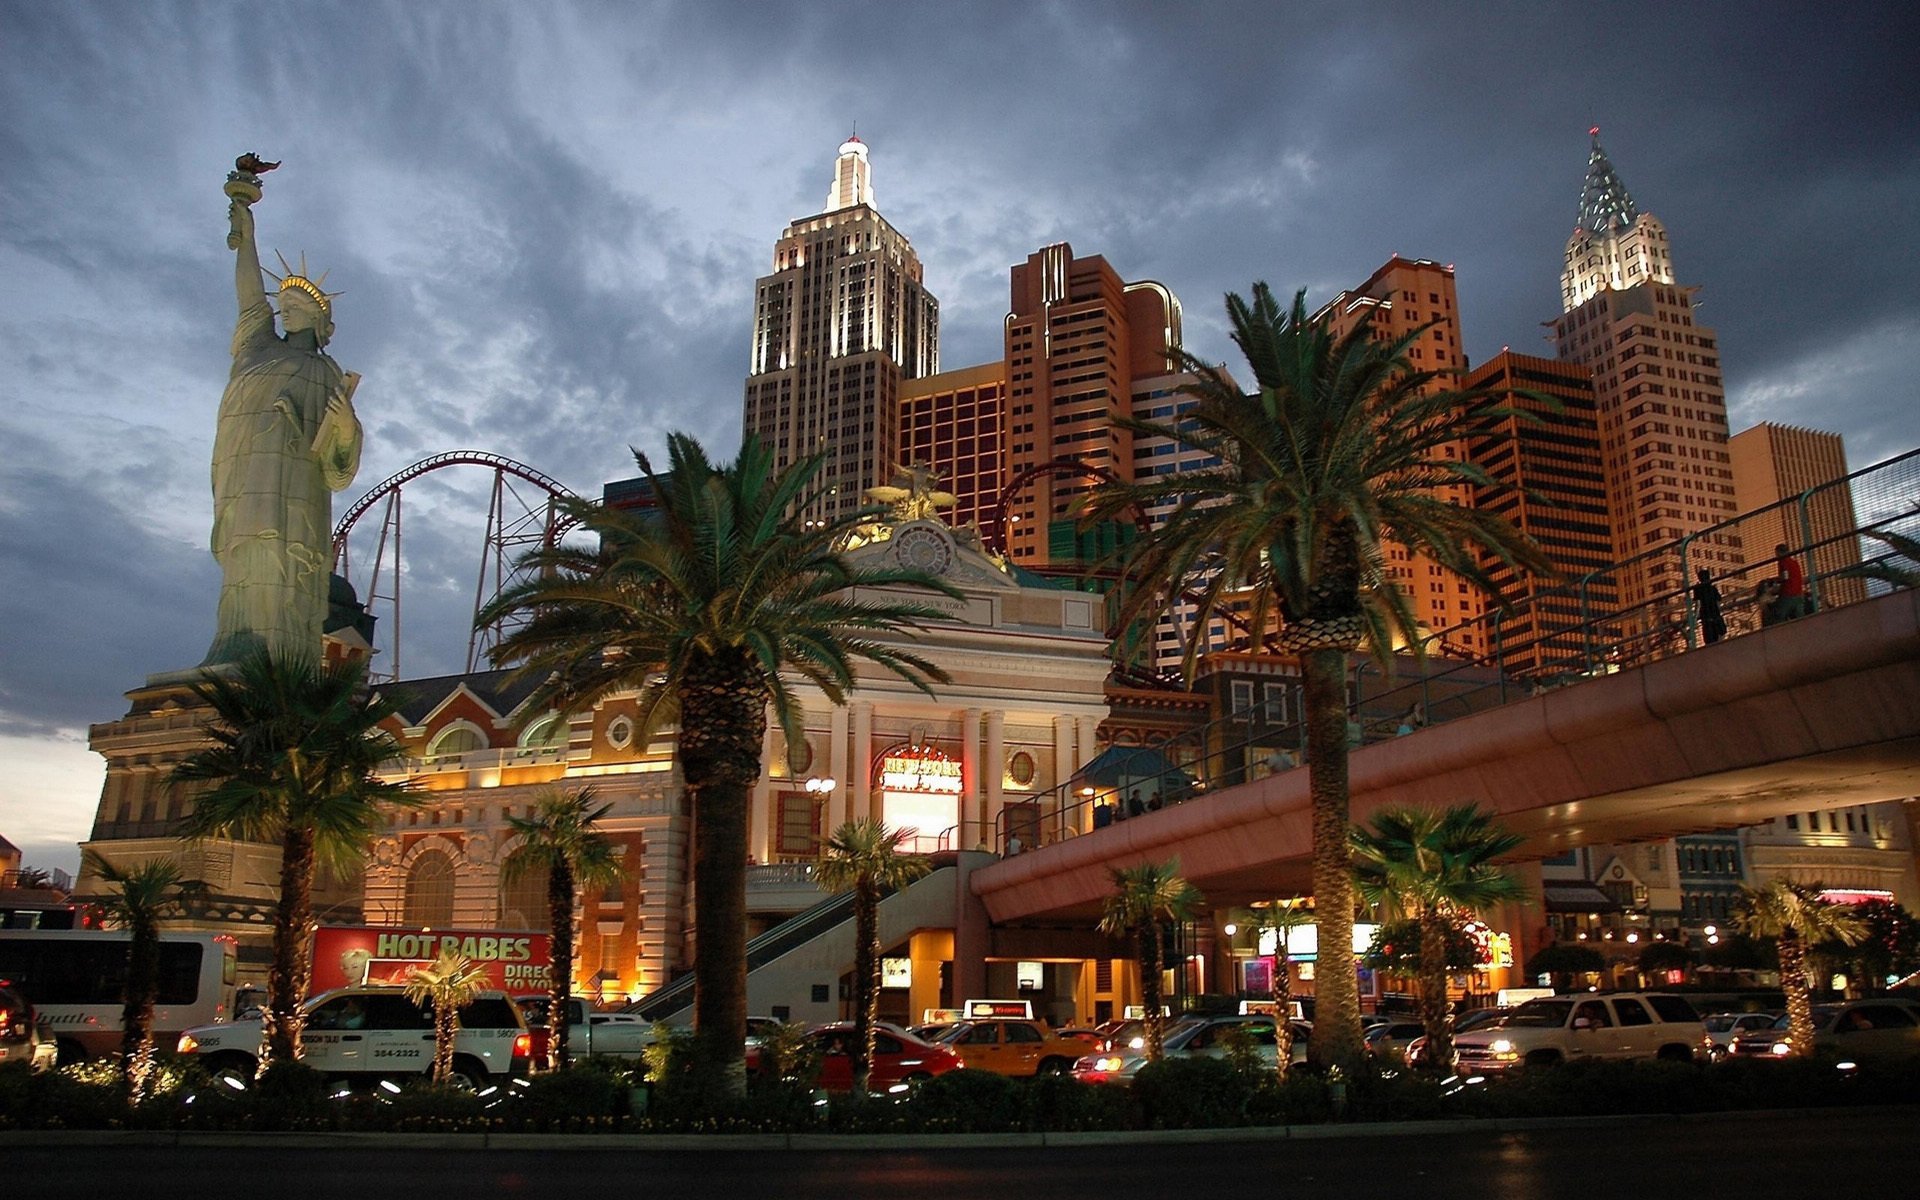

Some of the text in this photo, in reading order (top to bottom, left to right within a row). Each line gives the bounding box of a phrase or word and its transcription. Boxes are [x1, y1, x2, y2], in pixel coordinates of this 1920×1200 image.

[944, 601, 966, 610] YORK
[883, 757, 963, 777] NEW YORK
[377, 933, 531, 961] HOT BABES
[504, 964, 553, 979] DIREC
[504, 978, 525, 990] TO
[35, 1011, 96, 1025] huttle
